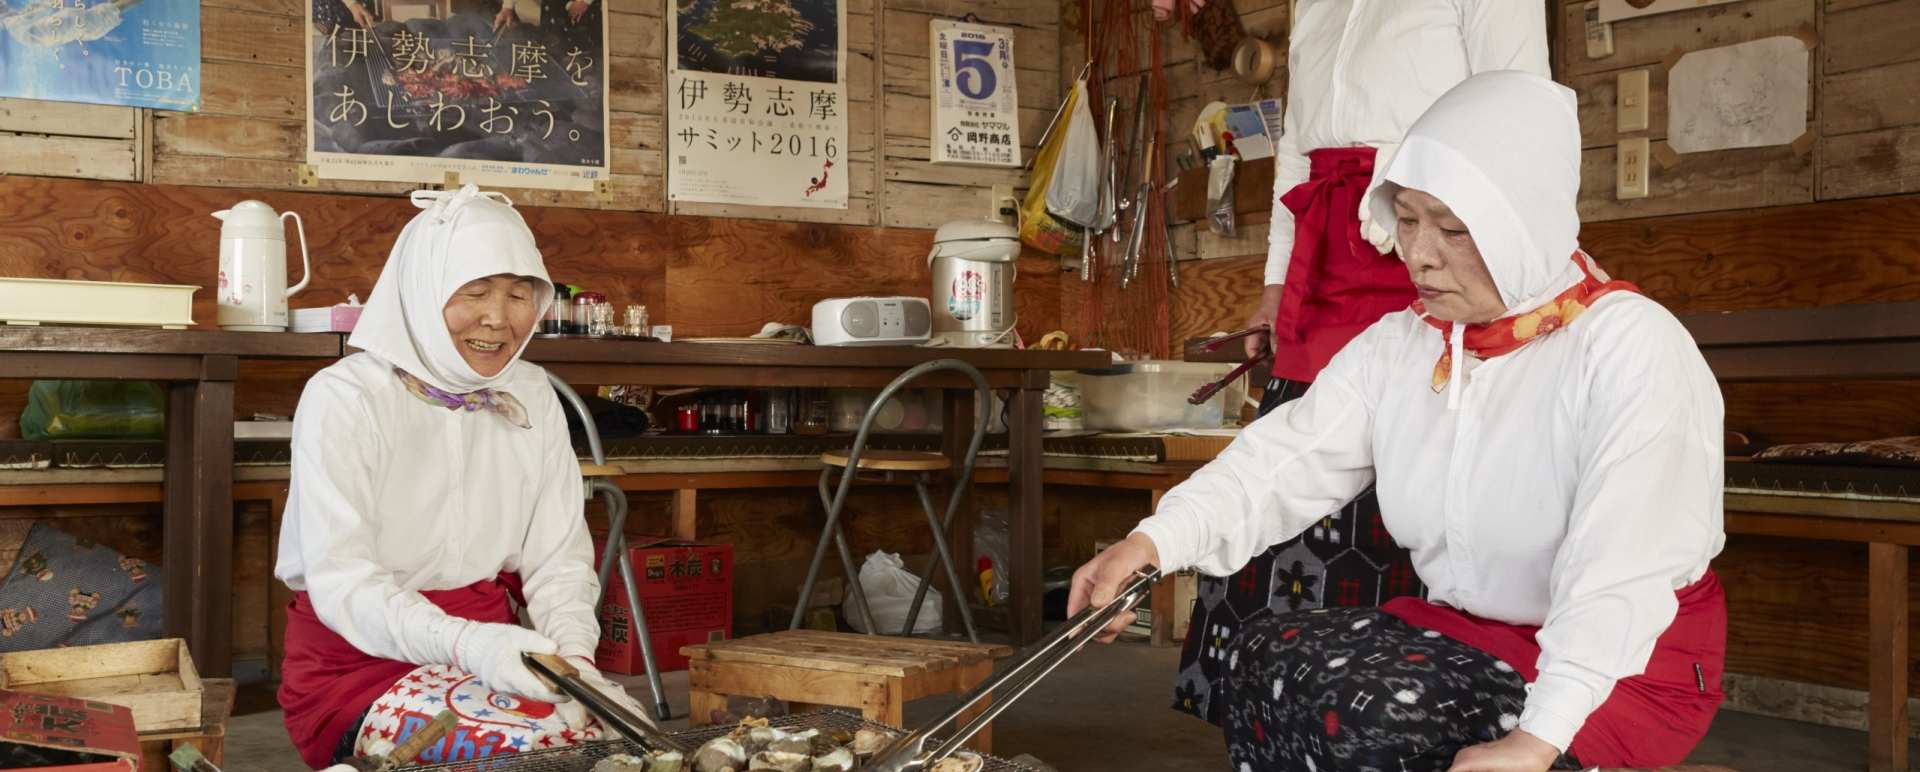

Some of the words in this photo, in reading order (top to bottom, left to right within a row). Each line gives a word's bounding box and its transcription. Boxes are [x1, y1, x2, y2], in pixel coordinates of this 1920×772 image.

[327, 23, 593, 86] 伊勢志摩を
[953, 39, 997, 100] 5
[113, 66, 193, 93] TOBA
[677, 77, 838, 121] 伊勢志摩
[329, 85, 581, 142] あじわおう。
[677, 126, 838, 158] サミット2016
[967, 131, 1011, 145] 岡野商店
